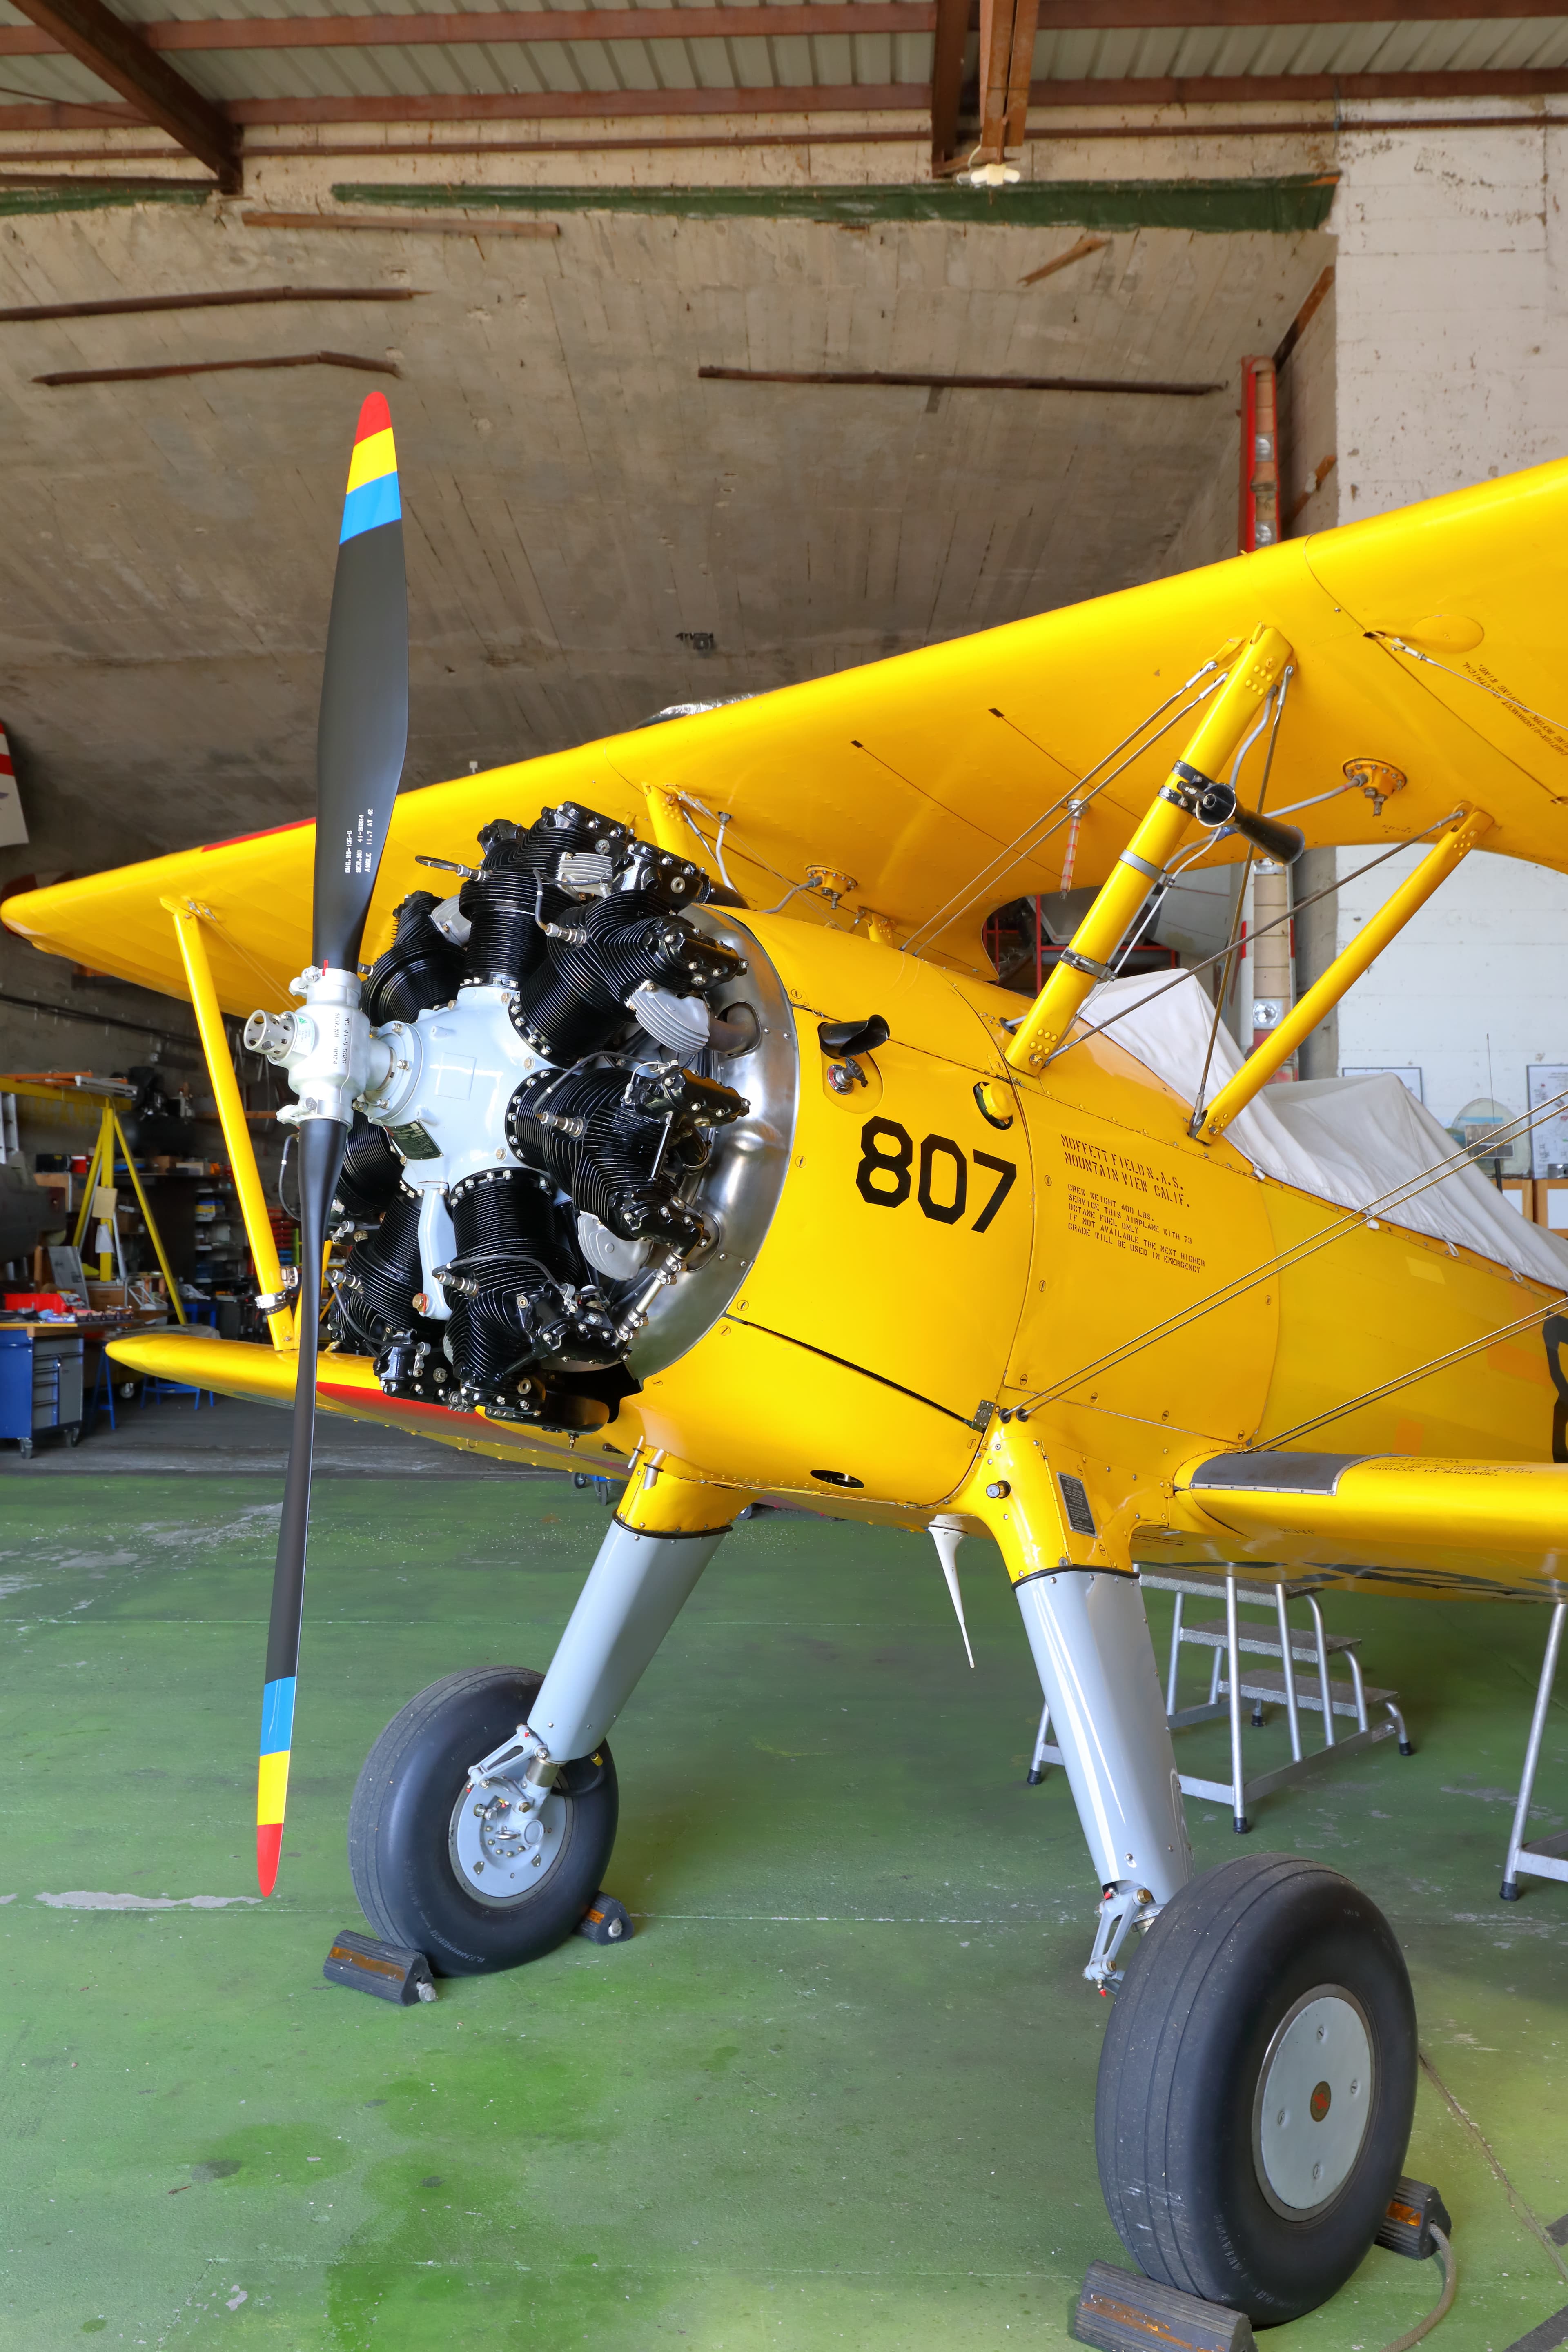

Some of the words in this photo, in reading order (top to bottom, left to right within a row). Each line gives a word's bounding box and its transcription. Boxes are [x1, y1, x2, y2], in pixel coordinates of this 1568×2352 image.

[1479, 664, 1499, 683] WING.
[856, 1116, 1017, 1233] 807
[1061, 1134, 1107, 1162] MOFFETT
[1111, 1153, 1145, 1176] FIELD
[1146, 1166, 1183, 1190] N.A.S.
[1064, 1151, 1119, 1182] MOUNTAIN
[1122, 1172, 1147, 1193] VIEW
[1154, 1185, 1190, 1208] CALIF.
[1068, 1184, 1085, 1196] CREW
[1090, 1192, 1116, 1207] WEIGHT
[1121, 1204, 1134, 1214] 400
[1138, 1209, 1154, 1221] LBS.
[1068, 1194, 1099, 1211] SERVICE
[1104, 1207, 1121, 1218] THIS
[1126, 1215, 1159, 1233] AIRPLANE
[1163, 1228, 1180, 1240] WITH
[1184, 1236, 1192, 1244] 73
[1069, 1203, 1095, 1219] OCTANE
[1100, 1214, 1117, 1227] FUEL
[1122, 1223, 1138, 1234] ONLY
[1068, 1223, 1090, 1236] GRADE
[1095, 1232, 1112, 1244] WILL
[1118, 1240, 1126, 1249] BE
[1130, 1244, 1147, 1256] USED
[1153, 1252, 1160, 1260] IN
[1164, 1256, 1200, 1273] EMERGENCY
[1070, 1213, 1078, 1221] IF
[1082, 1218, 1095, 1228] NOT
[1100, 1225, 1139, 1244] AVAILABLE
[1144, 1239, 1156, 1250] THE
[1160, 1245, 1176, 1256] NEXT
[1181, 1252, 1205, 1267] HIGHER
